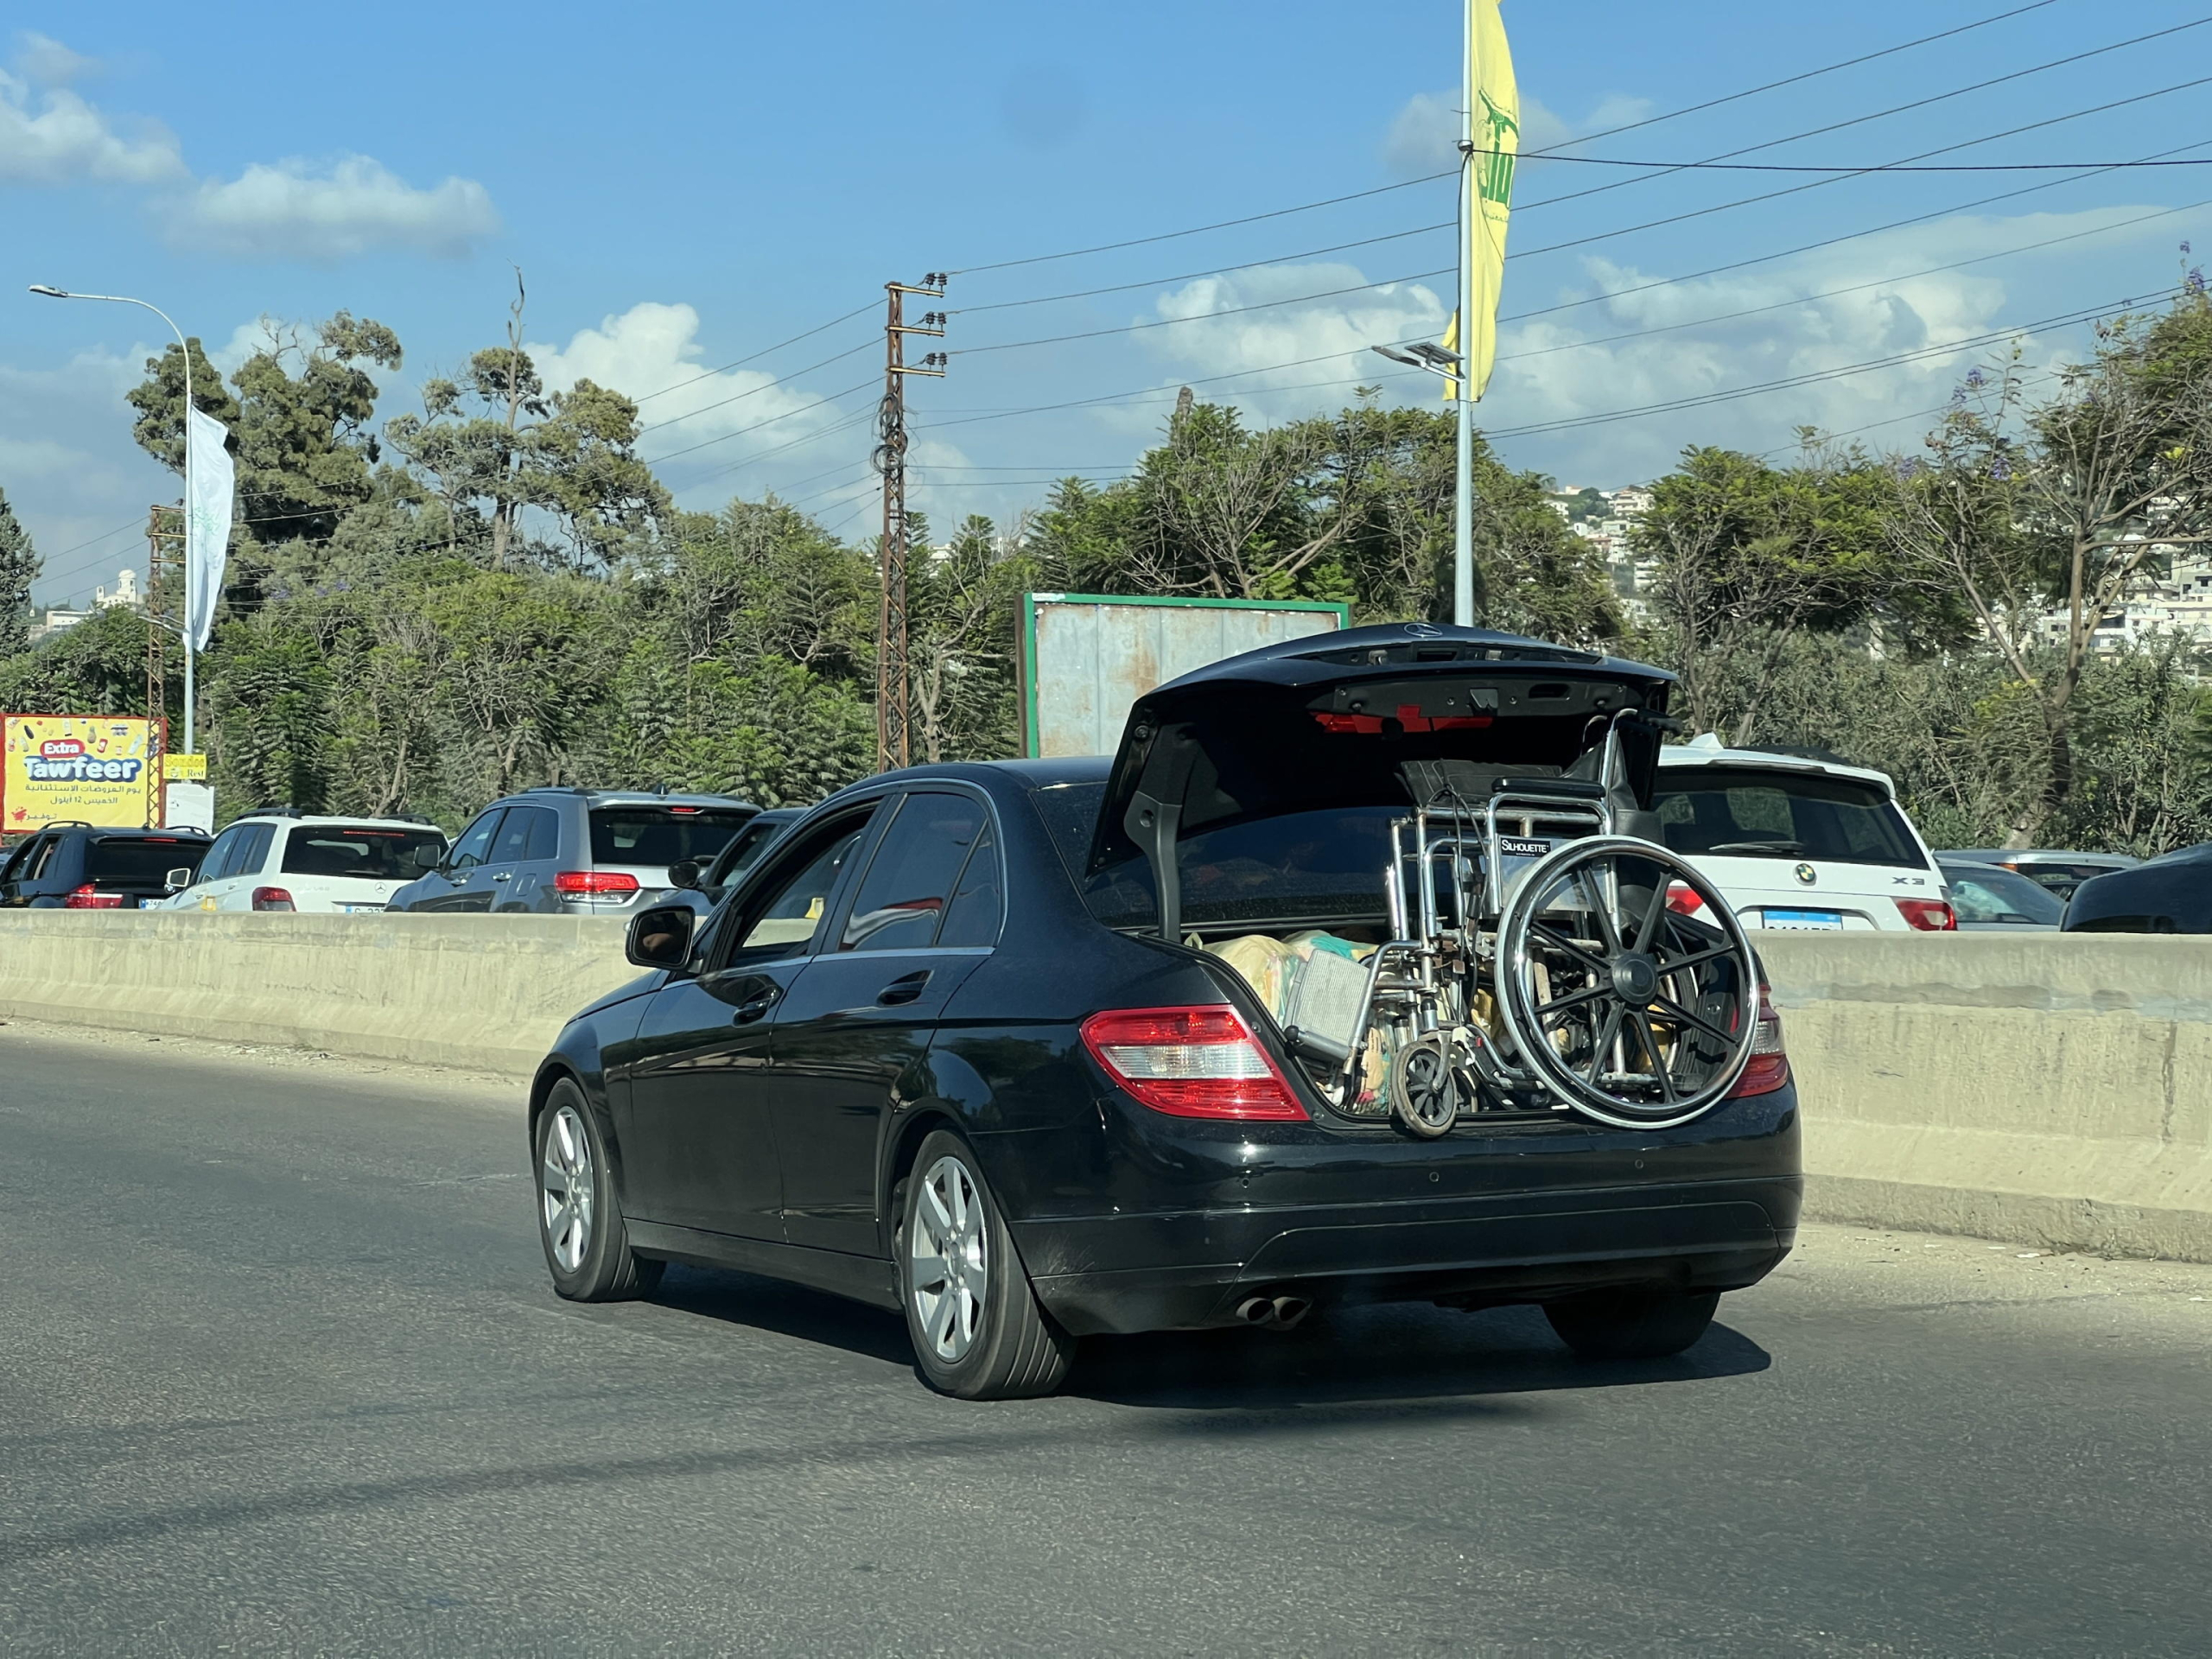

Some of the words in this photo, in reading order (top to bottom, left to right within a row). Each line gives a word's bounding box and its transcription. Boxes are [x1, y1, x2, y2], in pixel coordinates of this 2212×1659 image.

[44, 742, 79, 754] Extra
[24, 756, 137, 779] Tawfeer
[125, 785, 142, 795] يوم
[83, 797, 118, 805] الخميس
[1891, 876, 1925, 886] X3
